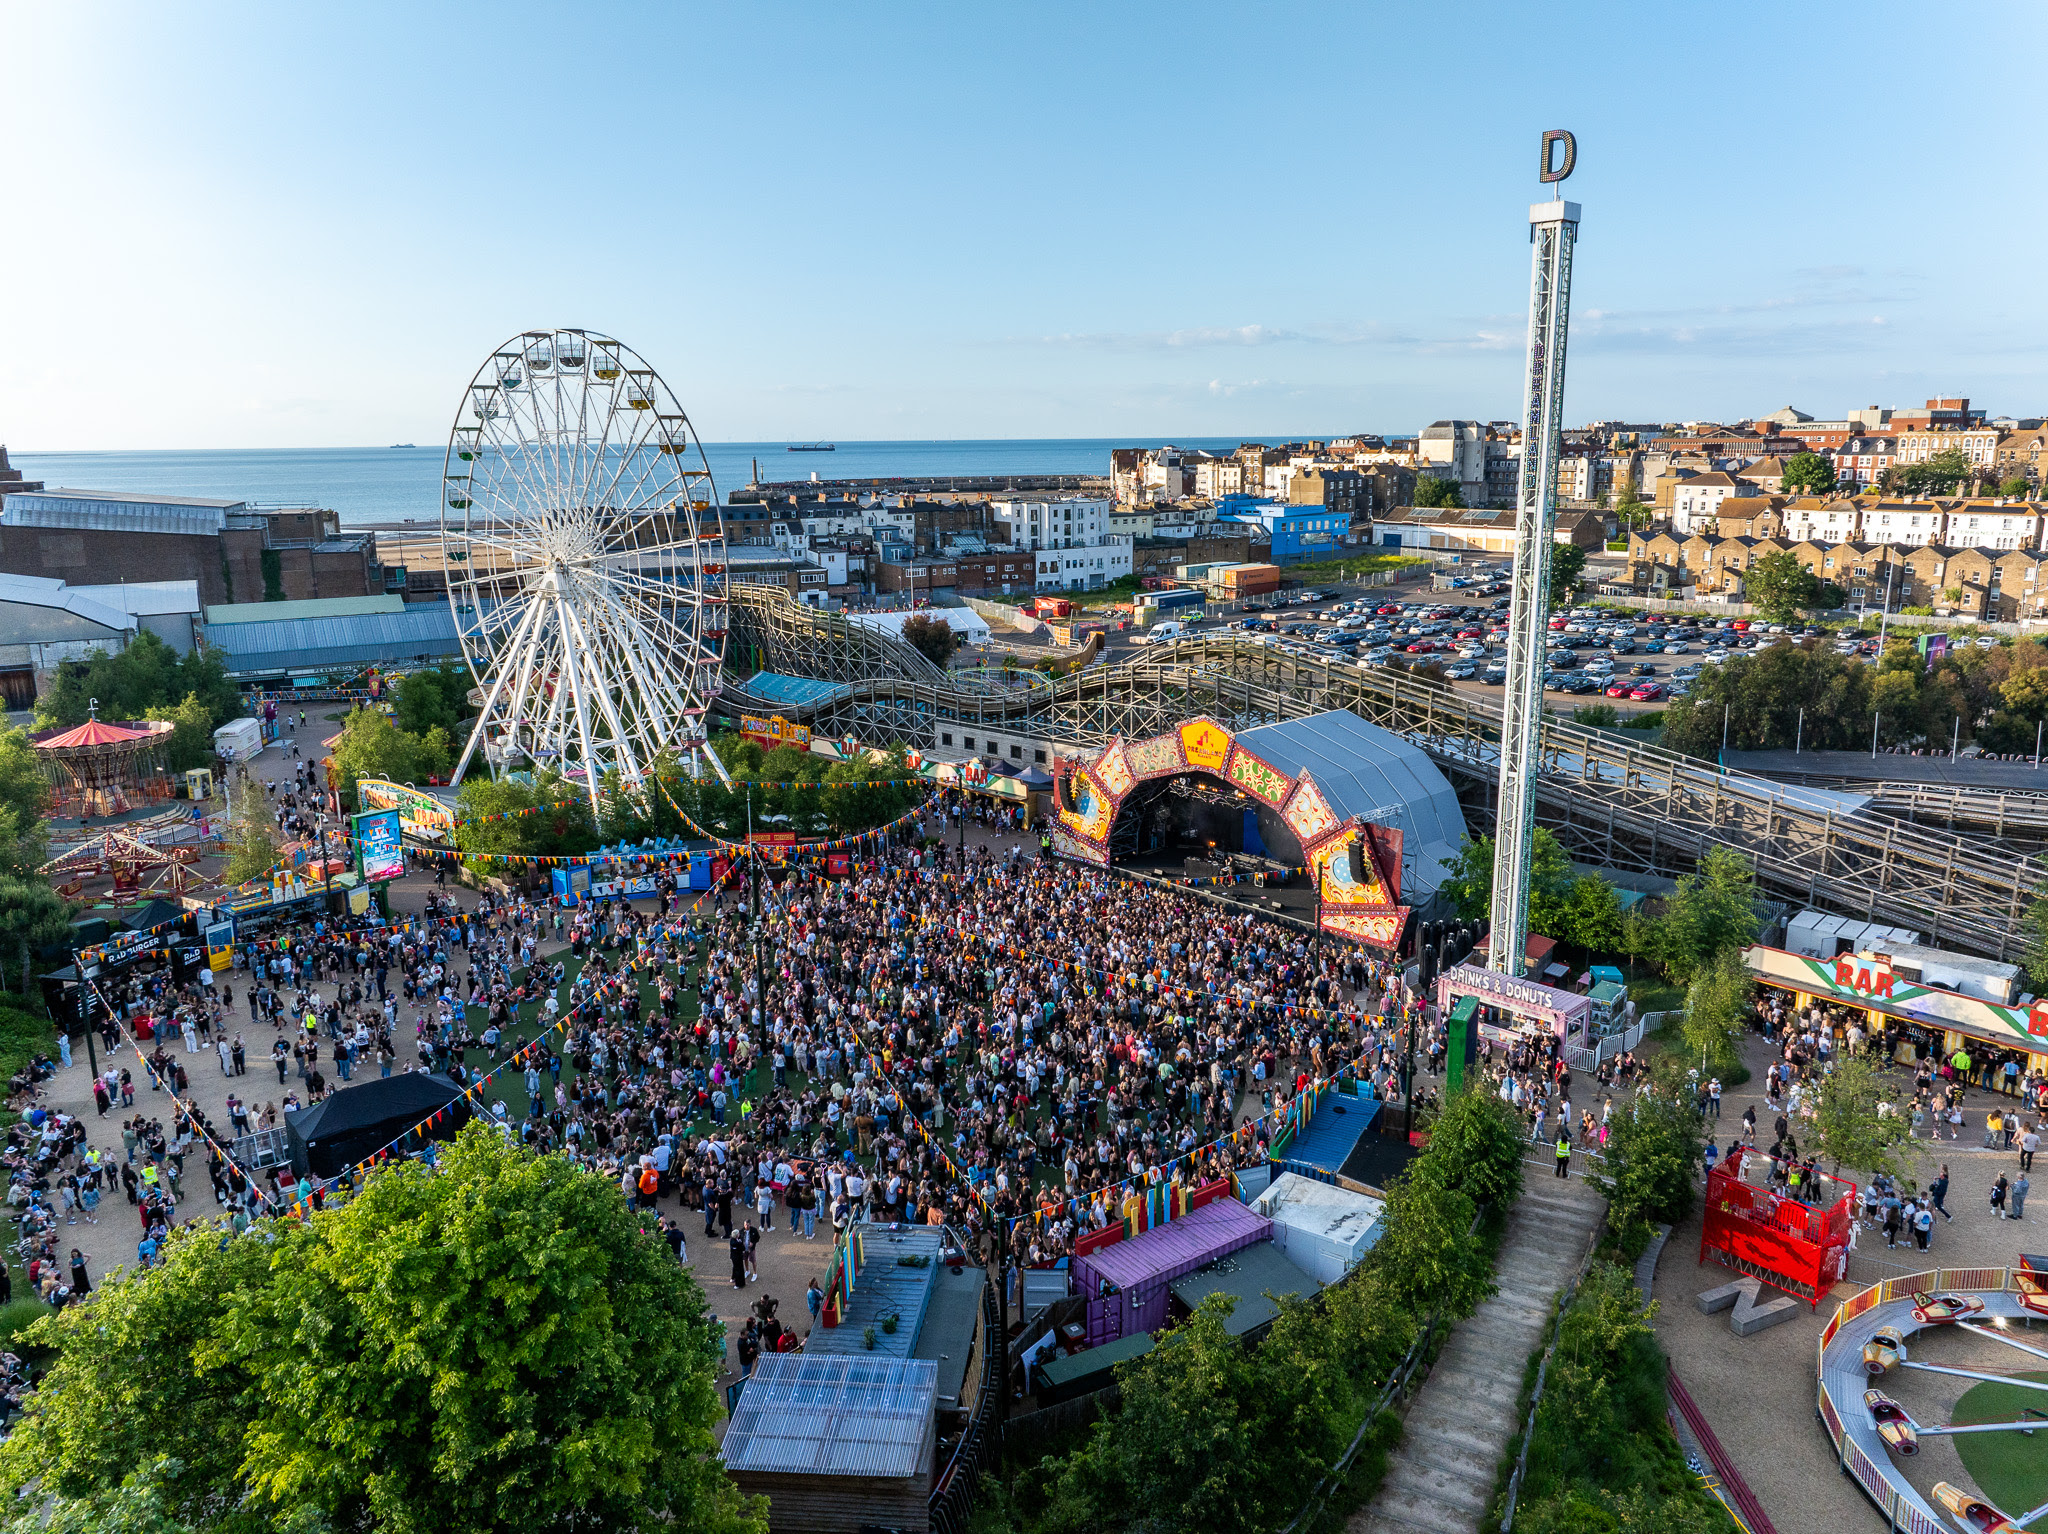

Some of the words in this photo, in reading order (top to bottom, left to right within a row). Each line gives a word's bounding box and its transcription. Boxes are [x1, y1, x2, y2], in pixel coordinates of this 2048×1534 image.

[1540, 129, 1577, 183] D
[1526, 343, 1545, 488] DREAMLAND
[841, 740, 860, 756] BAR
[903, 754, 921, 771] AR
[965, 766, 988, 785] BAR
[414, 808, 447, 826] TRAIN
[272, 882, 306, 904] BAR
[1450, 965, 1490, 990] DRINKS
[1494, 979, 1500, 994] &
[1506, 981, 1552, 1008] DONUTS
[1835, 962, 1894, 999] BAR
